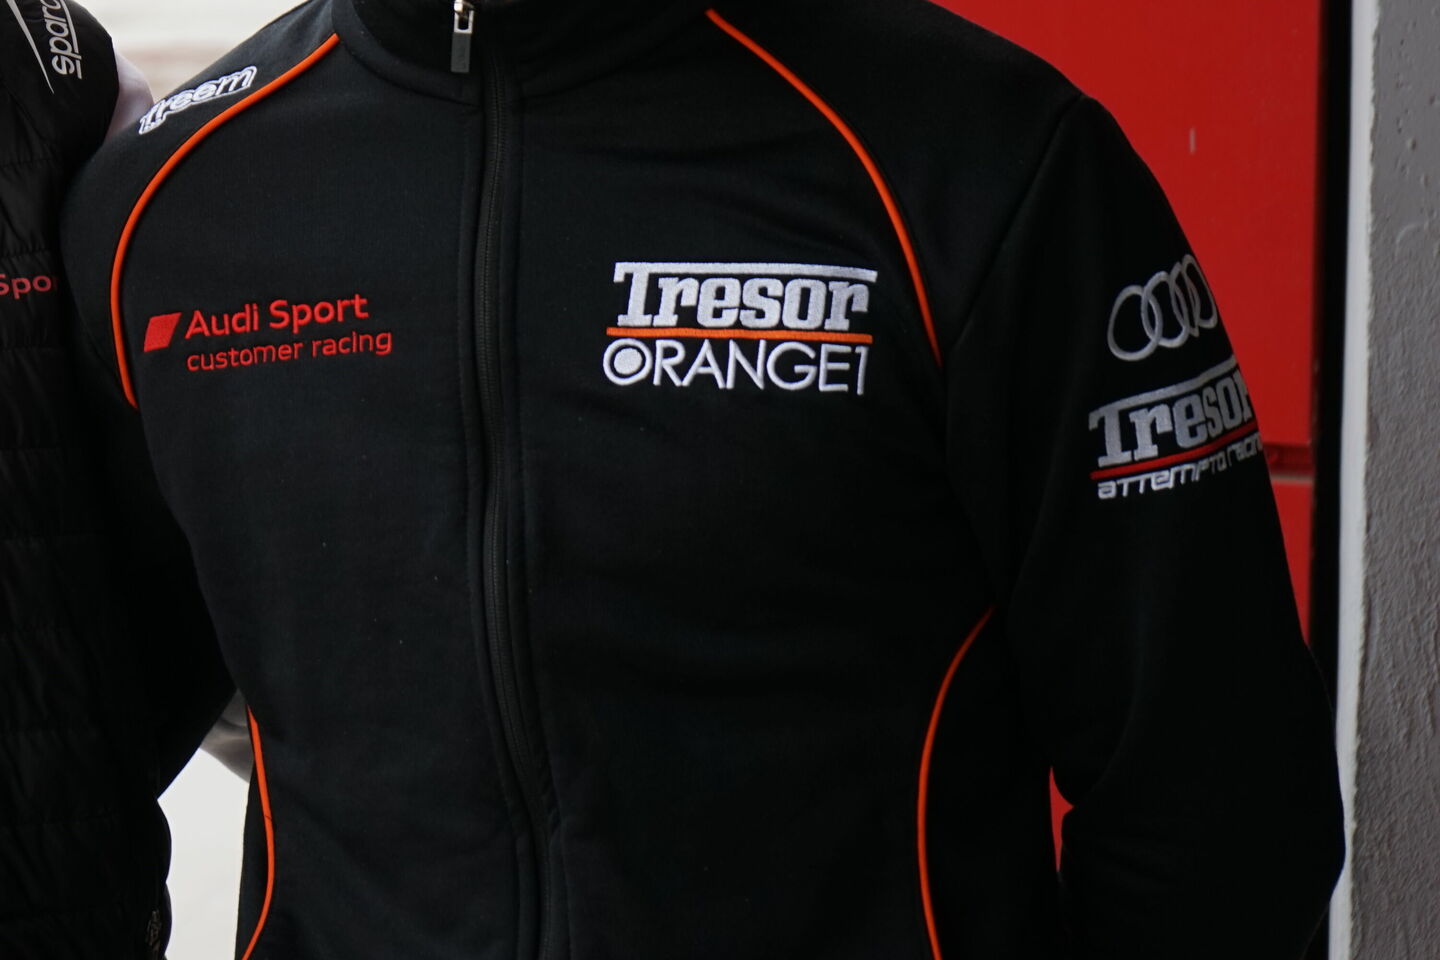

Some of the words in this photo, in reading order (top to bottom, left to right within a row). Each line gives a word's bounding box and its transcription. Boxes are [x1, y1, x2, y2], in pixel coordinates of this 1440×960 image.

[138, 65, 257, 135] freem
[184, 303, 259, 339] Audi
[268, 293, 369, 333] Sport
[612, 261, 878, 331] Tresor
[186, 342, 303, 371] customer
[311, 331, 393, 356] racing
[602, 338, 870, 396] ORANGE1
